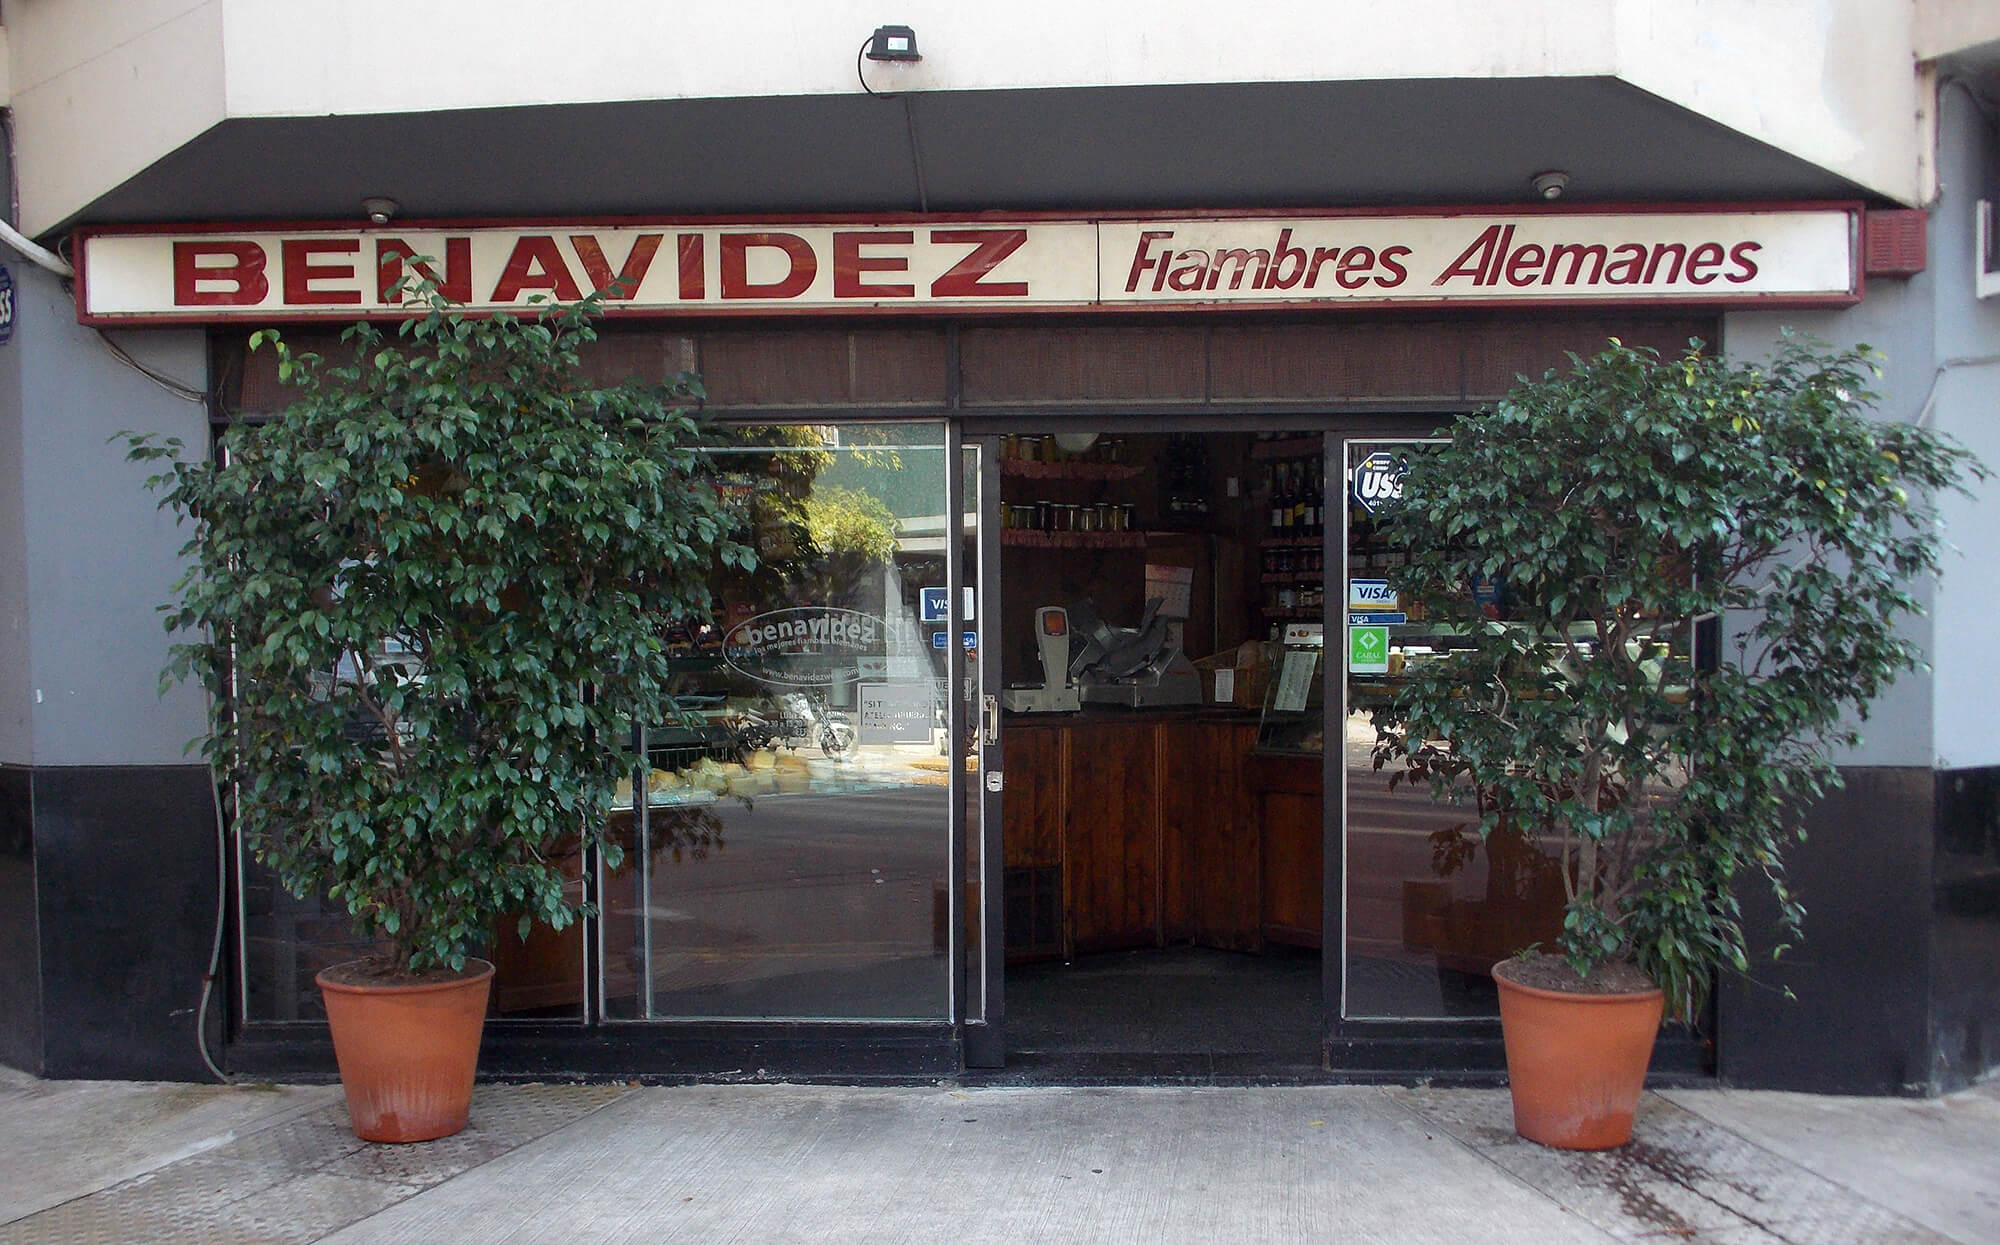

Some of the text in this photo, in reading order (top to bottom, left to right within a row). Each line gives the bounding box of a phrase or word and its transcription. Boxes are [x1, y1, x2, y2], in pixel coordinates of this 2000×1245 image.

[173, 229, 1030, 307] BENAVIDEZ
[1124, 224, 1763, 293] Fiambres Alemanes
[0, 287, 12, 325] SS
[931, 599, 949, 610] VIS
[1357, 586, 1390, 599] VISA
[743, 612, 875, 646] benavidez
[1351, 615, 1369, 624] VISA
[762, 667, 860, 681] www.benavidezwom
